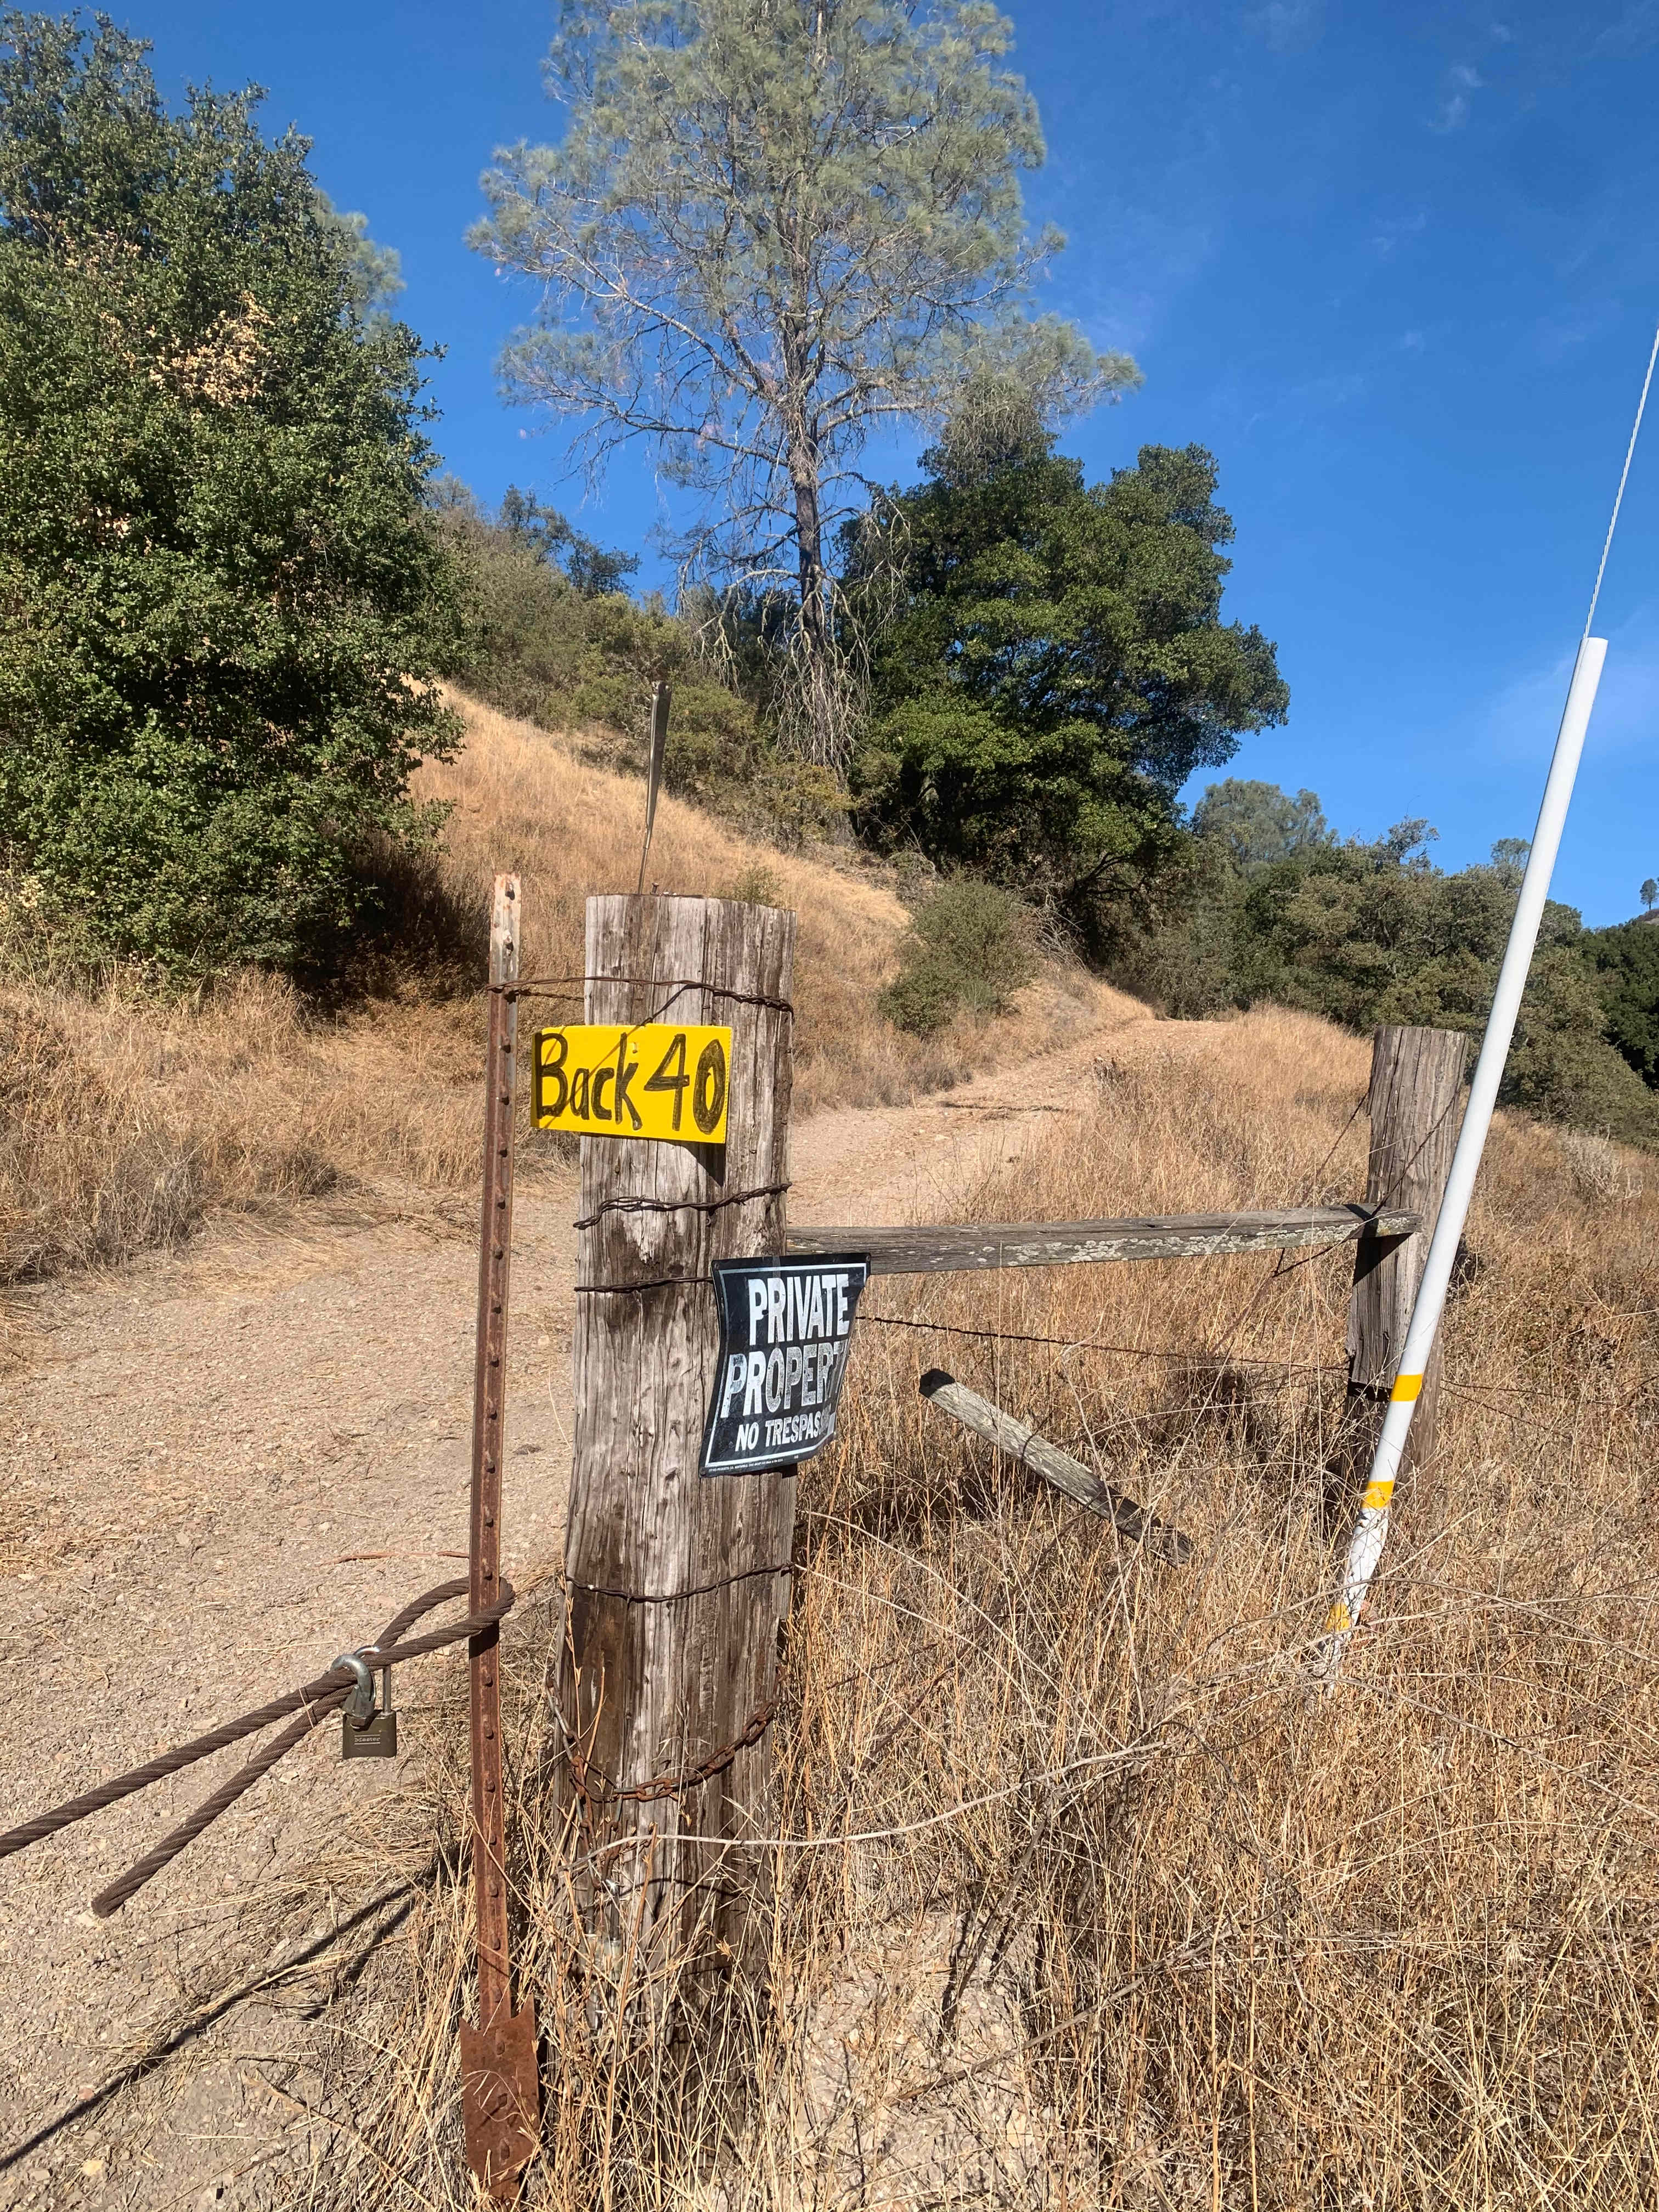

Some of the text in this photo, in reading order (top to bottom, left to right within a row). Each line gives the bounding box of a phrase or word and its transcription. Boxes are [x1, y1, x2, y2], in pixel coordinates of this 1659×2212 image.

[535, 1032, 726, 1135] Back 40
[747, 1273, 849, 1346] PRIVATE
[720, 1339, 848, 1418] PROPERT
[735, 1404, 831, 1452] NO TRESPAS
